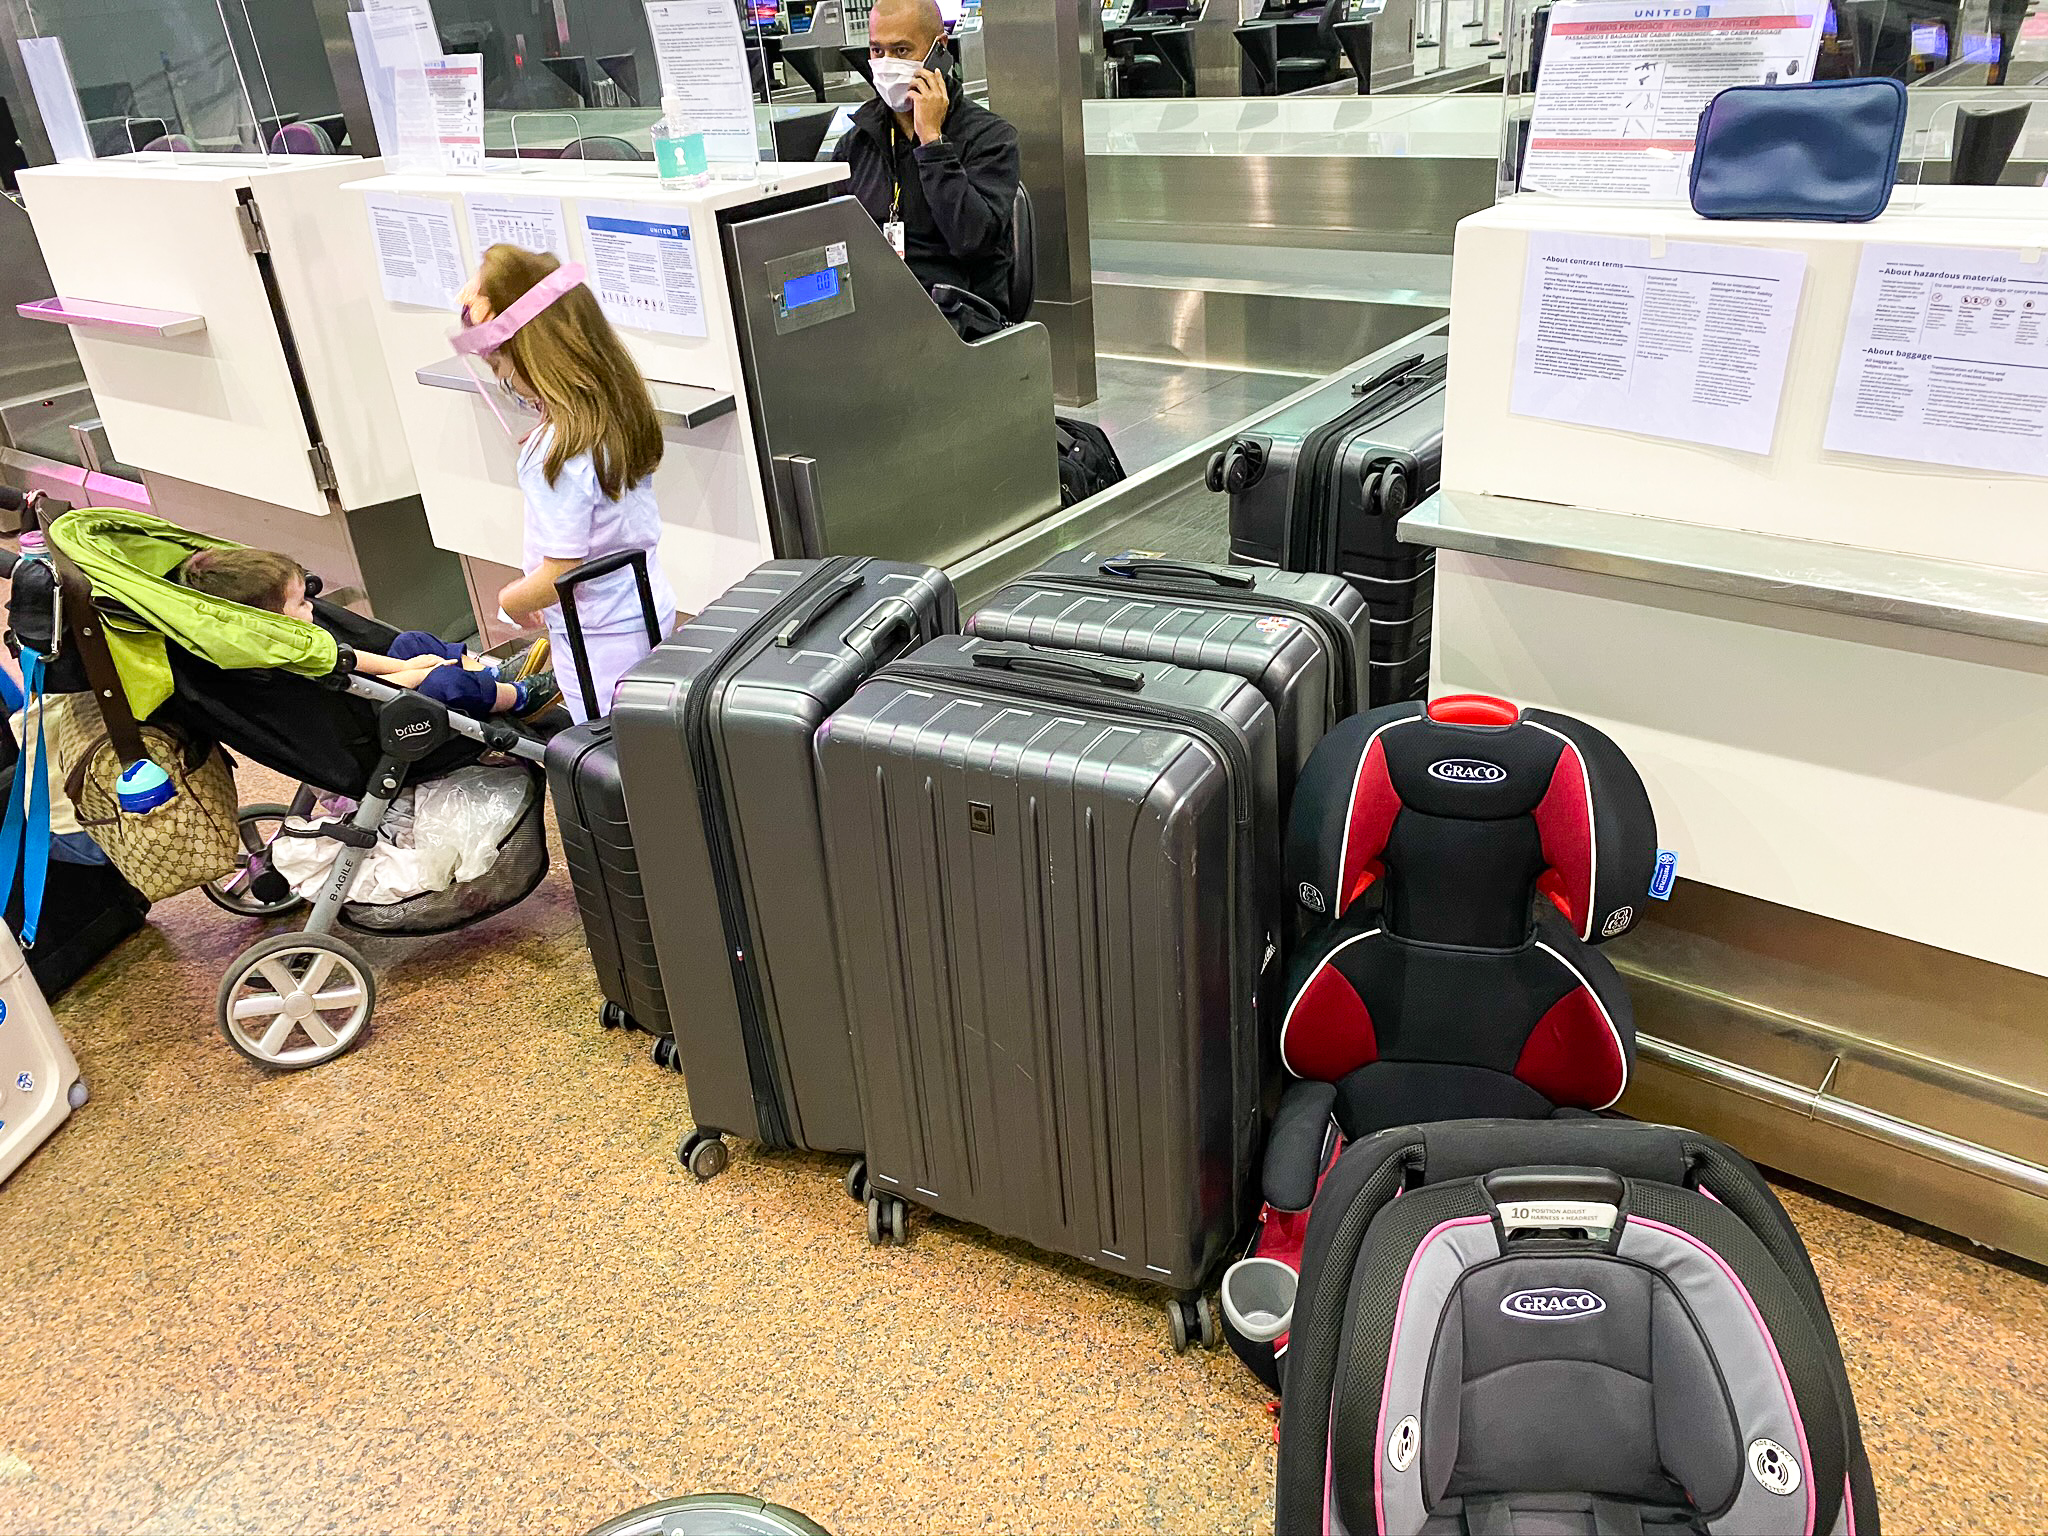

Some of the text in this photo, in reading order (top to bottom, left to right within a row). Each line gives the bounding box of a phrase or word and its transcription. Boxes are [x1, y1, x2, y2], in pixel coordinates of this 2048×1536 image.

[1634, 8, 1692, 18] UNITED
[1583, 23, 1617, 31] ARTIGOS
[1620, 22, 1664, 30] PERIGOSOS
[1672, 20, 1719, 29] PROHIBITED
[1720, 18, 1760, 27] ARTICLES
[649, 227, 671, 235] UNITED
[1546, 255, 1568, 264] About
[1570, 258, 1600, 267] contract
[1884, 267, 2007, 283] About hazardous materials
[1867, 347, 1933, 361] About baggage
[394, 719, 431, 737] britax
[1438, 762, 1499, 780] GRACO
[329, 858, 354, 902] B-AGILE
[1511, 1207, 1530, 1219] 10
[1514, 1294, 1596, 1311] GRACO
[1769, 1441, 1794, 1463] IMPACT
[1761, 1479, 1786, 1494] TESTED
